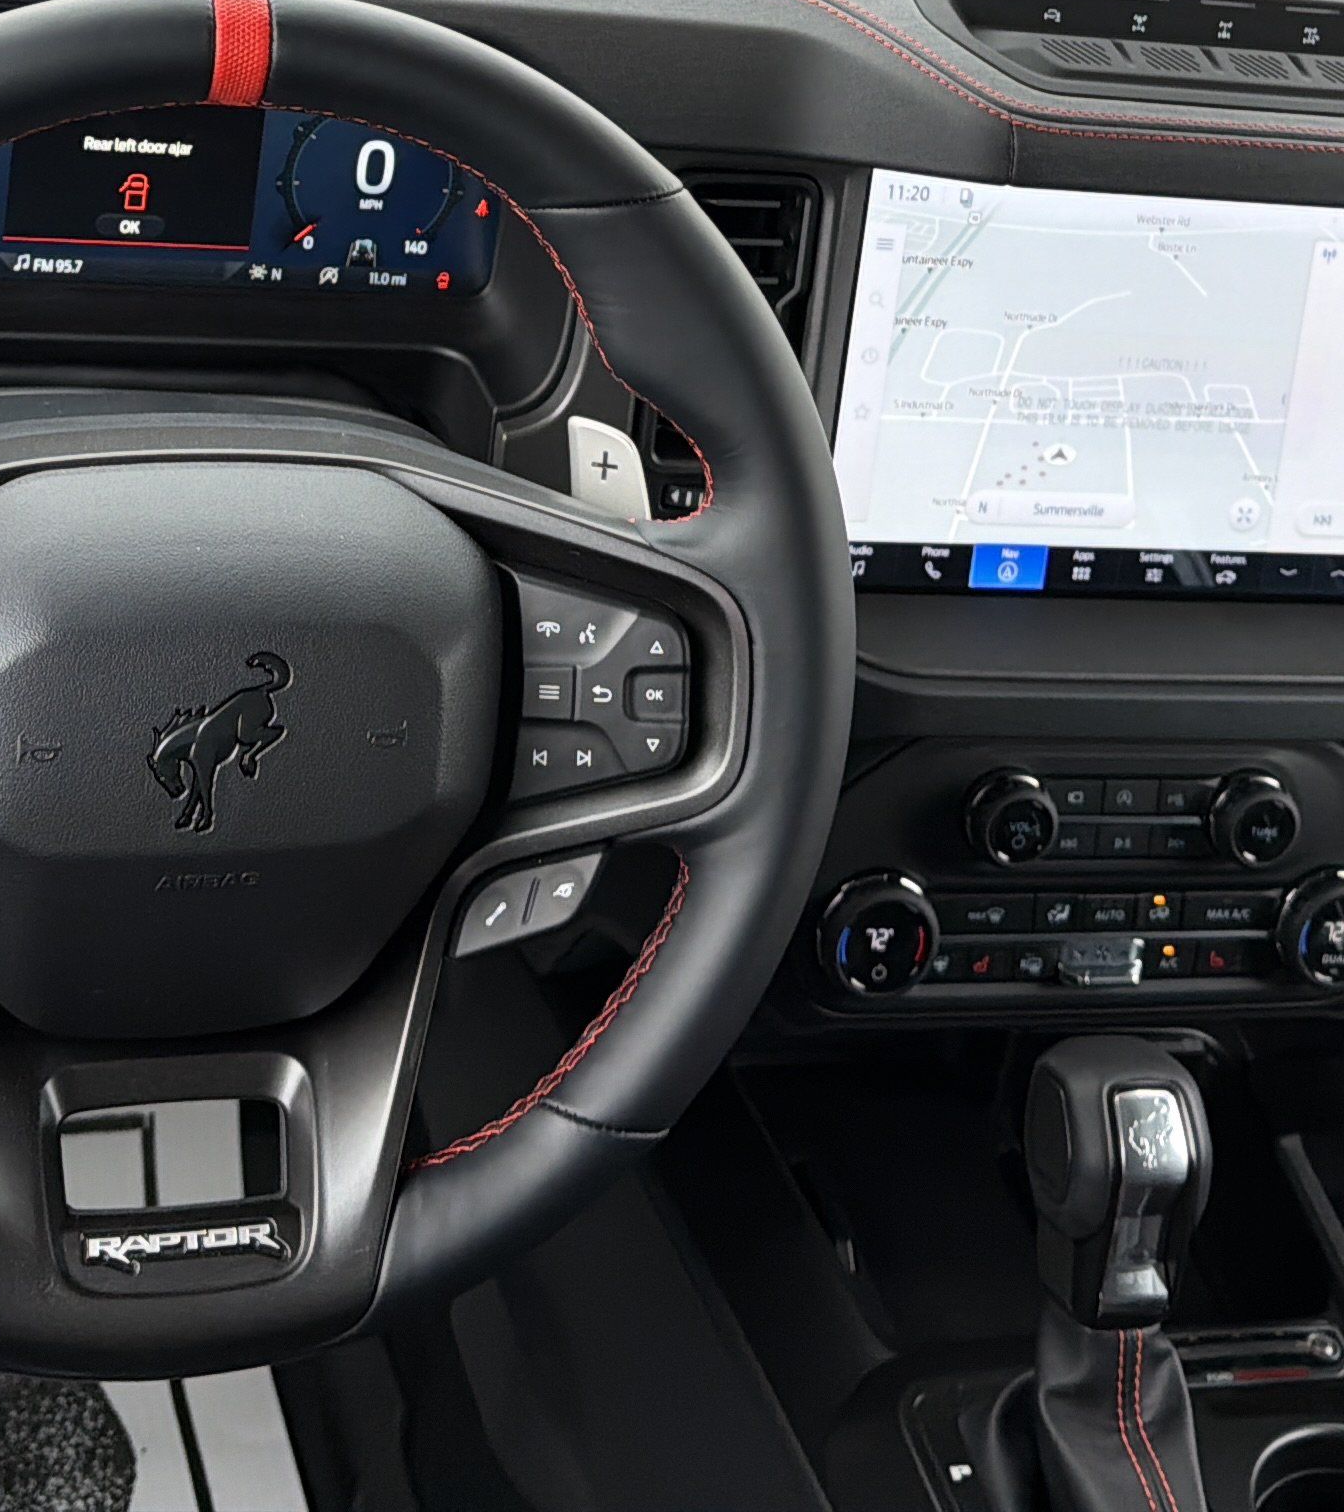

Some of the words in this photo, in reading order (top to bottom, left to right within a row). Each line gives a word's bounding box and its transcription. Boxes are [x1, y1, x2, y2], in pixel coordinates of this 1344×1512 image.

[83, 135, 112, 152] Rear
[114, 137, 137, 153] left
[138, 138, 167, 154] door
[169, 141, 194, 157] ajar
[356, 140, 395, 195] 0
[888, 184, 931, 202] 11:20
[359, 198, 384, 211] MPH
[119, 219, 142, 235] OK
[302, 235, 314, 250] 0
[404, 240, 428, 255] 140
[32, 257, 54, 273] FM
[54, 258, 83, 274] 95.7
[978, 501, 988, 514] N
[1033, 502, 1105, 518] Summersville
[921, 546, 951, 558] Phone
[1001, 548, 1020, 560] Nav
[1072, 550, 1095, 563] Apps
[1139, 551, 1175, 565] Settings
[645, 688, 664, 702] OK
[156, 870, 260, 890] AIRBAG
[1094, 910, 1126, 922] AUTO
[86, 1223, 282, 1265] RAPTOR
[949, 1464, 973, 1482] P
